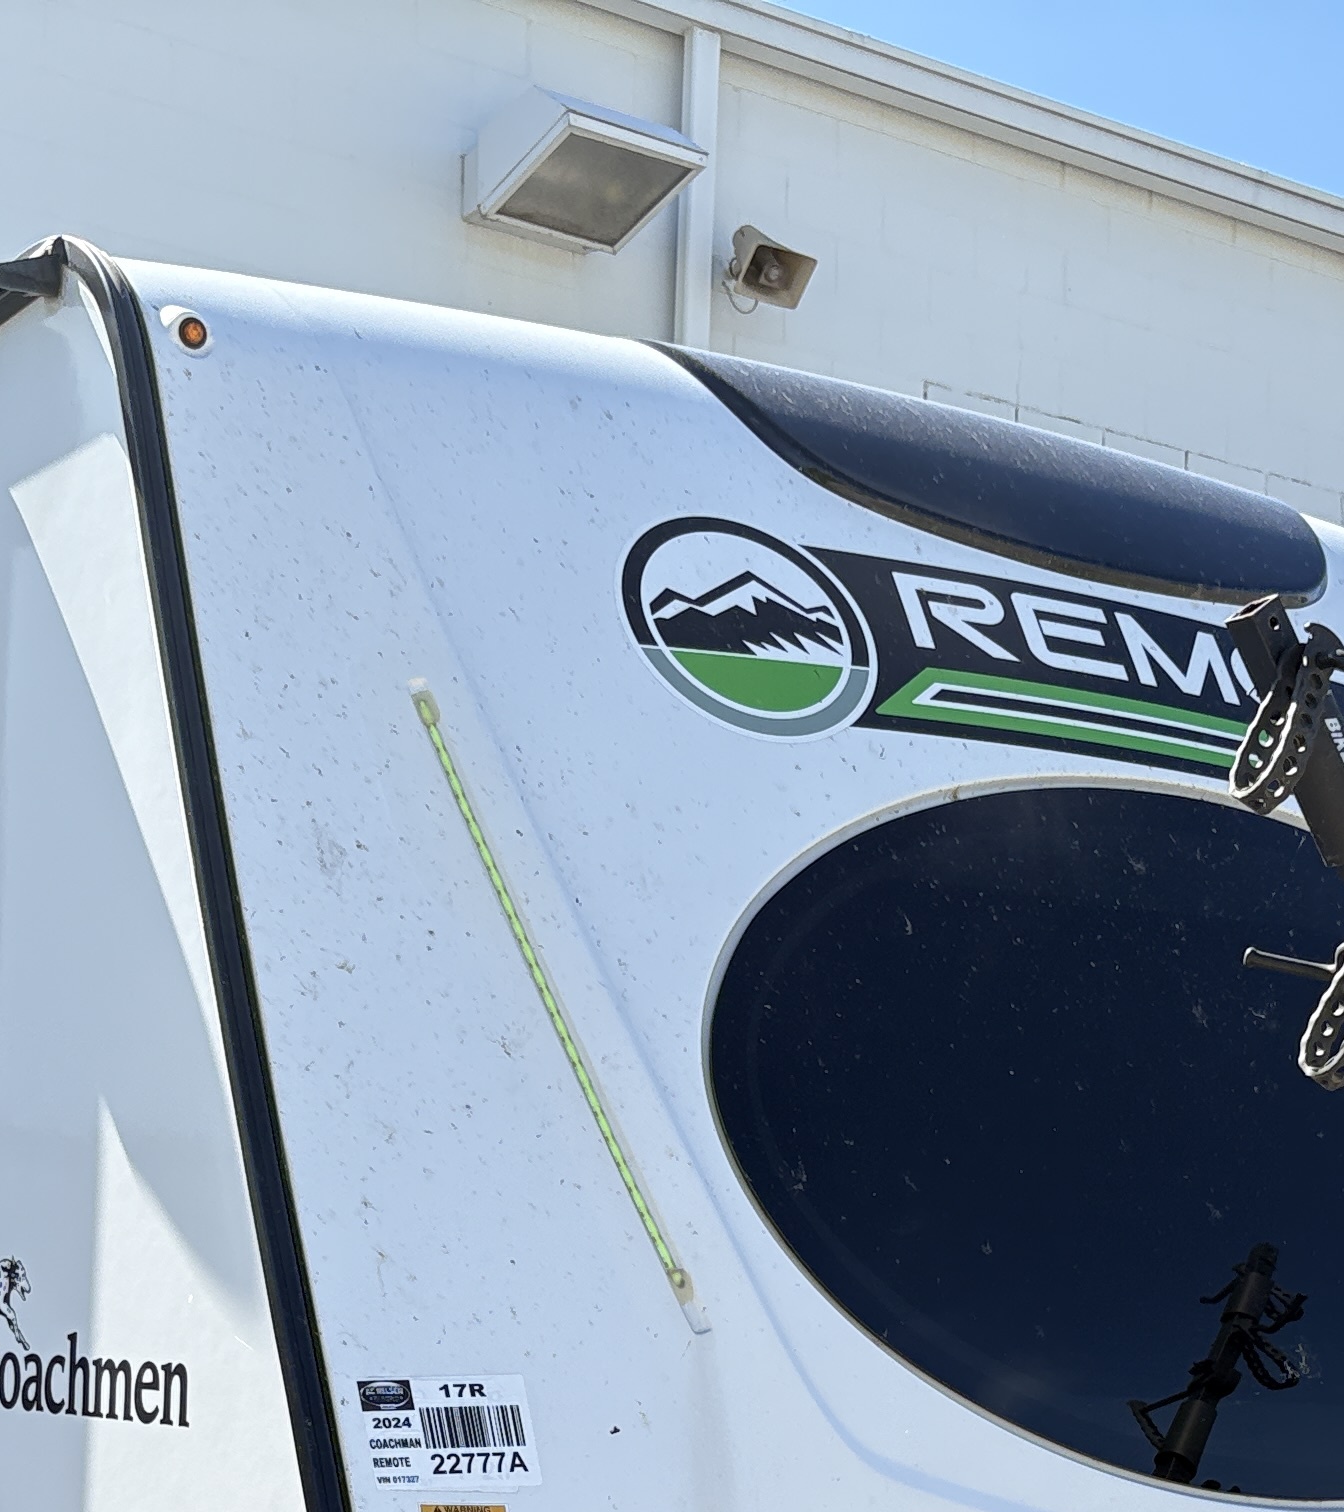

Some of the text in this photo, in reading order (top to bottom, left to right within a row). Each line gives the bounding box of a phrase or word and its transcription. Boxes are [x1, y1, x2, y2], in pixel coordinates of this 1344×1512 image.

[438, 1383, 488, 1398] 17R
[371, 1416, 413, 1430] 2024
[369, 1437, 422, 1450] COACHMAN
[372, 1456, 412, 1469] REMOTE
[430, 1451, 530, 1475] 22777A
